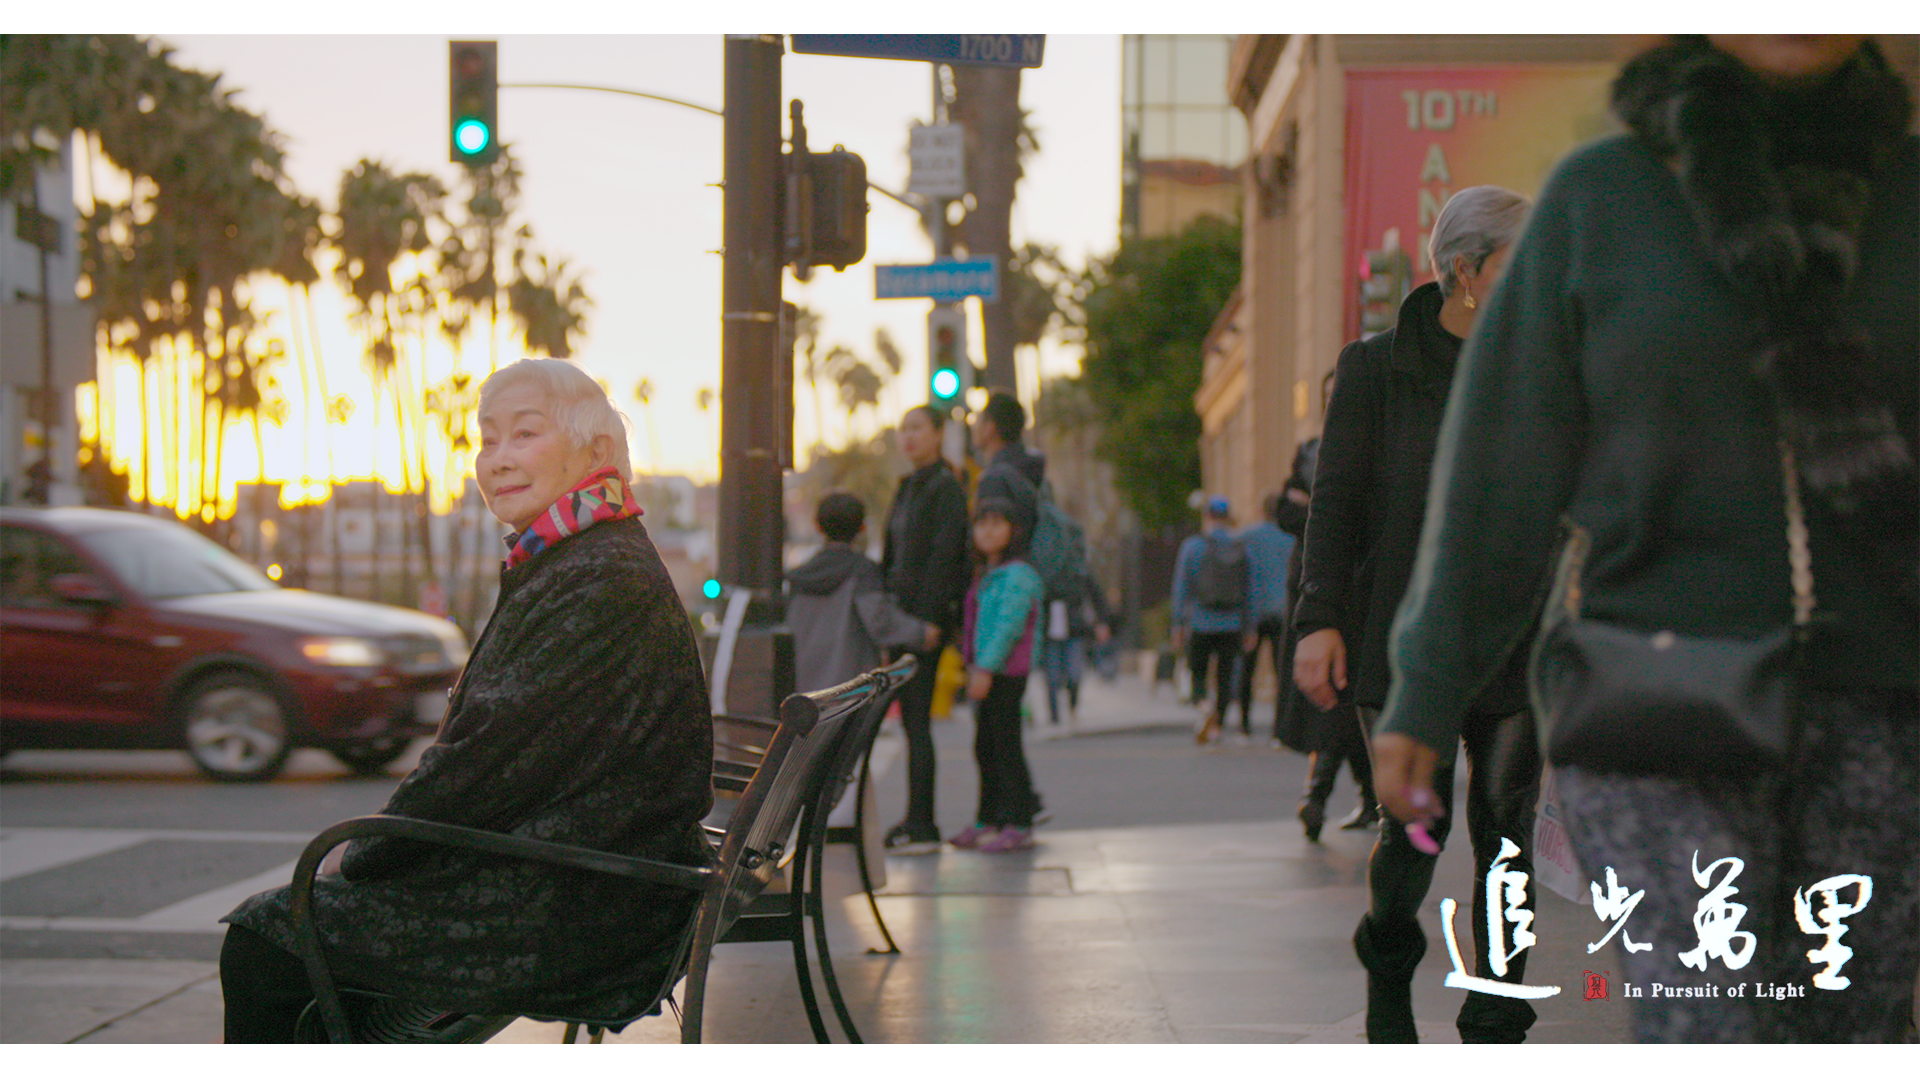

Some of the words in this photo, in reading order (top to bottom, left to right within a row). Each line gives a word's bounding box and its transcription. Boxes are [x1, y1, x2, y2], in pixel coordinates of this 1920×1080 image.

[960, 34, 1012, 60] 1700
[1022, 36, 1039, 61] N
[1402, 89, 1498, 131] 10TH
